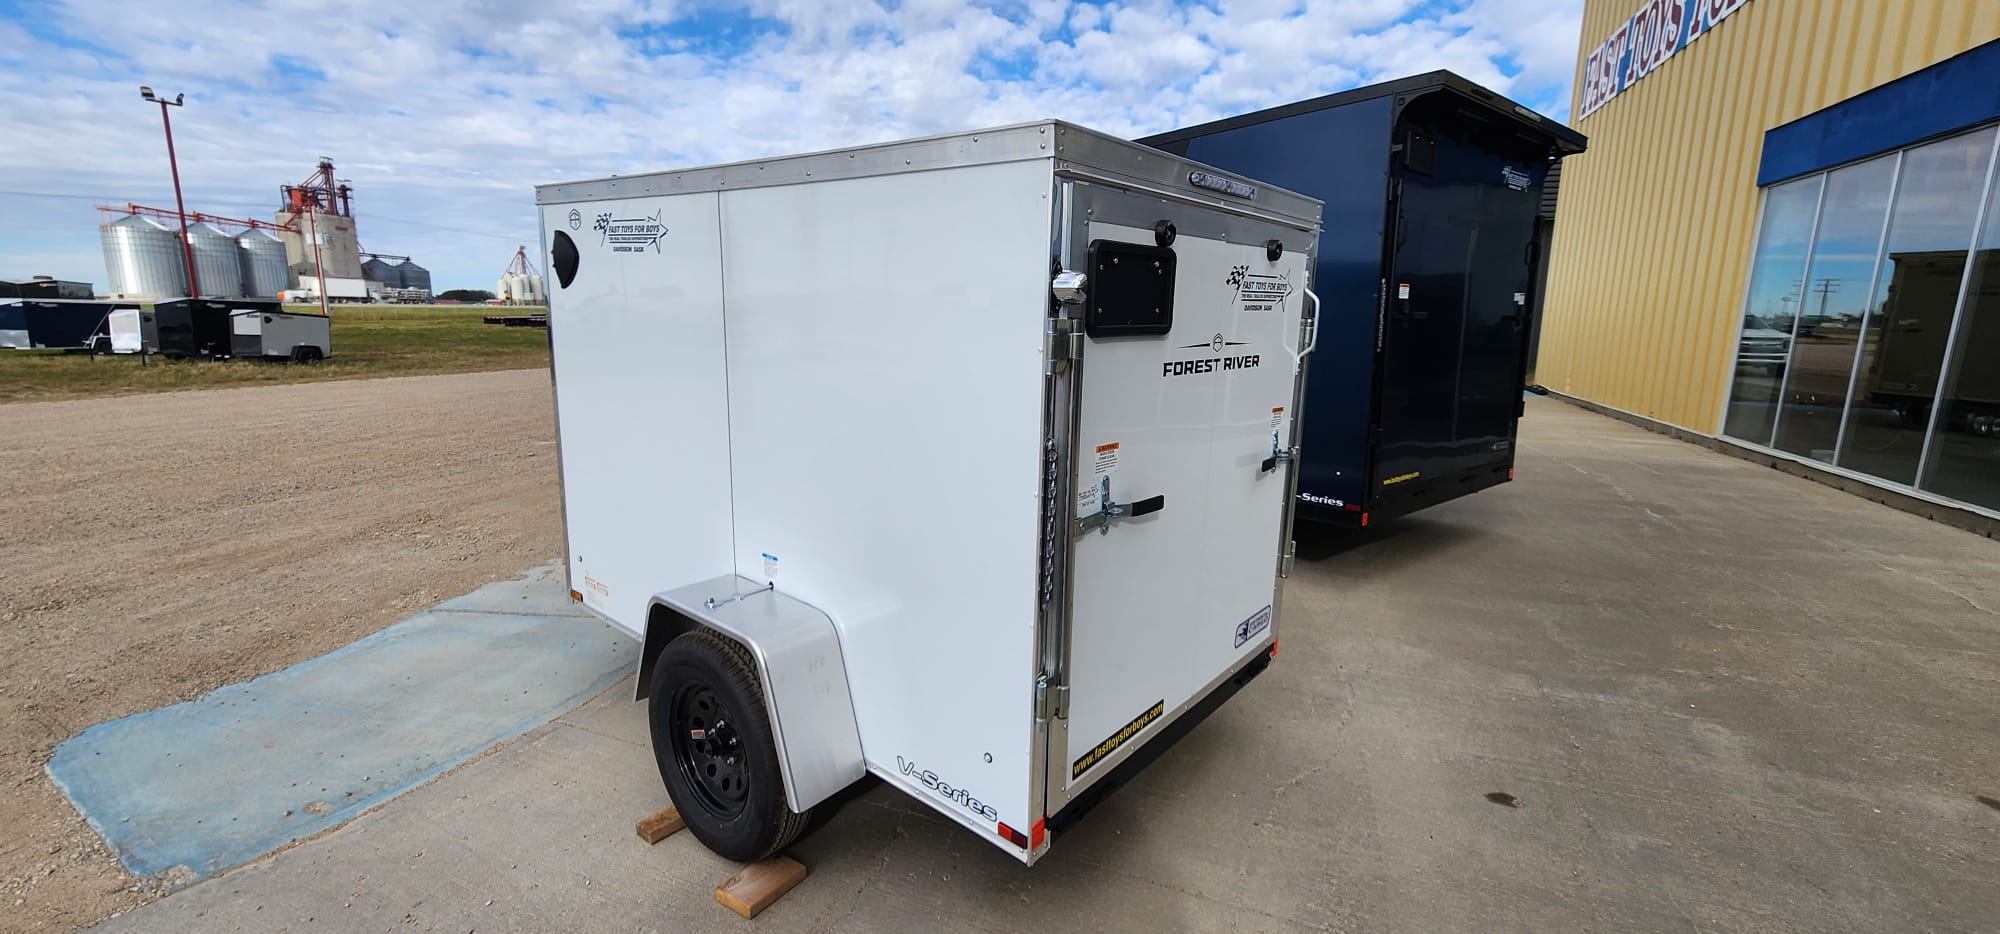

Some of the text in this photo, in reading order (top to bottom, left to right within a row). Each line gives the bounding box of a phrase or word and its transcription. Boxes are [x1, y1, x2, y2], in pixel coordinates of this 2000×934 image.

[1580, 26, 1629, 117] FAST
[1625, 0, 1684, 83] TOYS
[608, 225, 660, 233] FAST TOYS FOR BOYS
[1242, 281, 1288, 291] FAST TOYS FOR BOYS
[1162, 355, 1260, 378] FOREST RIVER
[896, 755, 998, 823] V-Series
